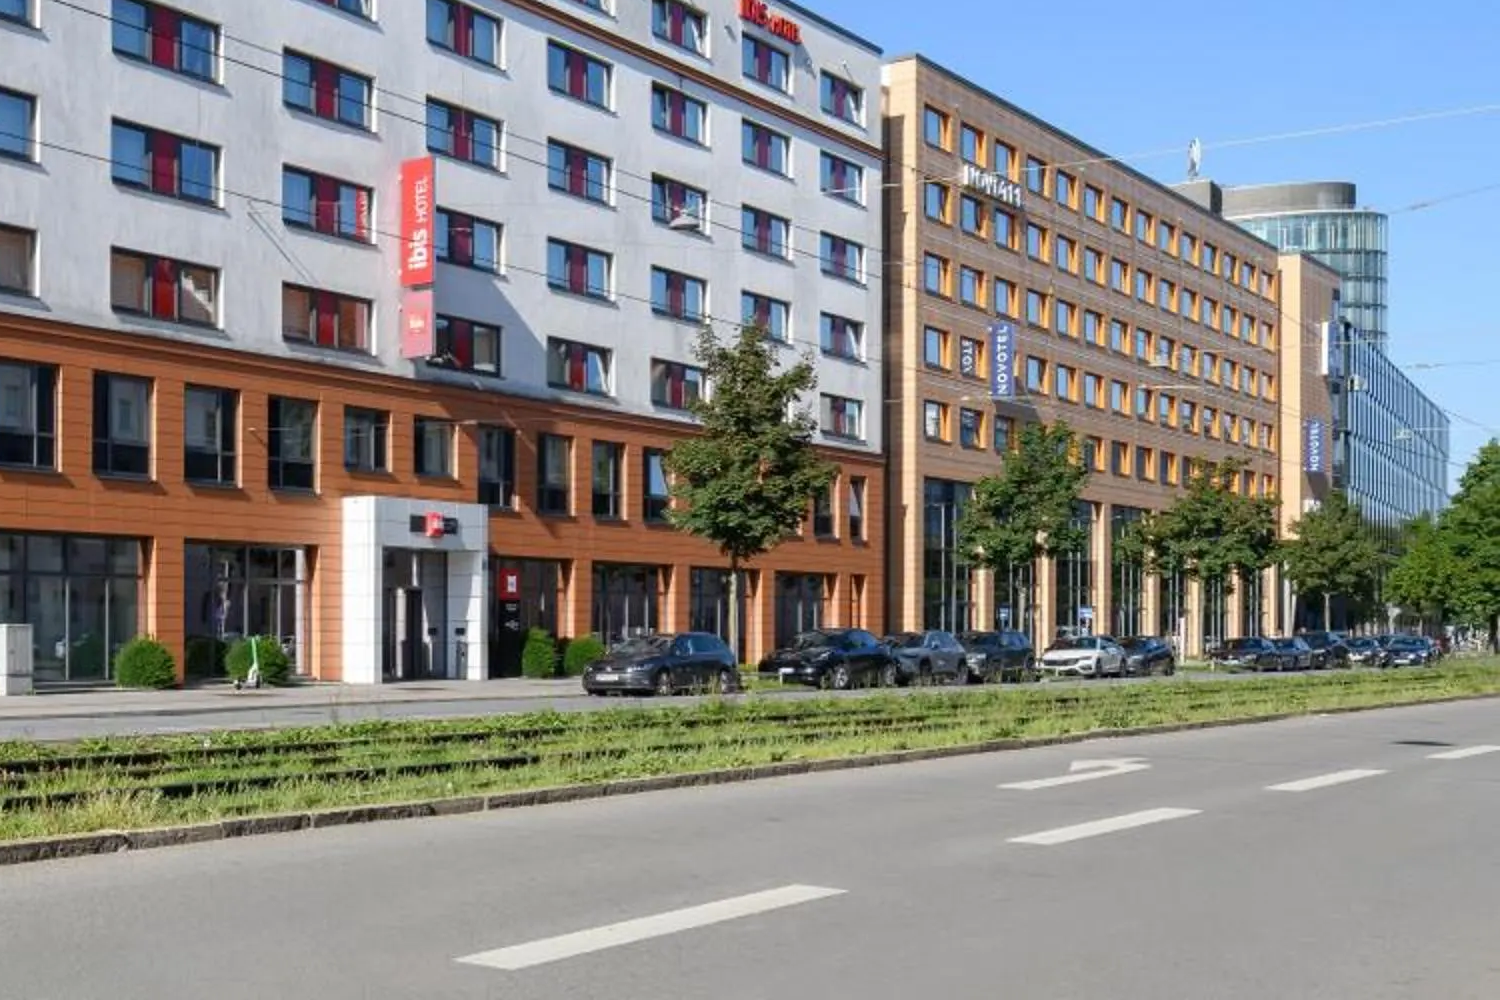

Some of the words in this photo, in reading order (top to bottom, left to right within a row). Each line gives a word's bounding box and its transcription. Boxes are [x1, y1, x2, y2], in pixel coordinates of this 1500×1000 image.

[414, 176, 429, 224] HOTEL
[408, 228, 428, 271] ibis
[996, 325, 1008, 394] NOVOTEL
